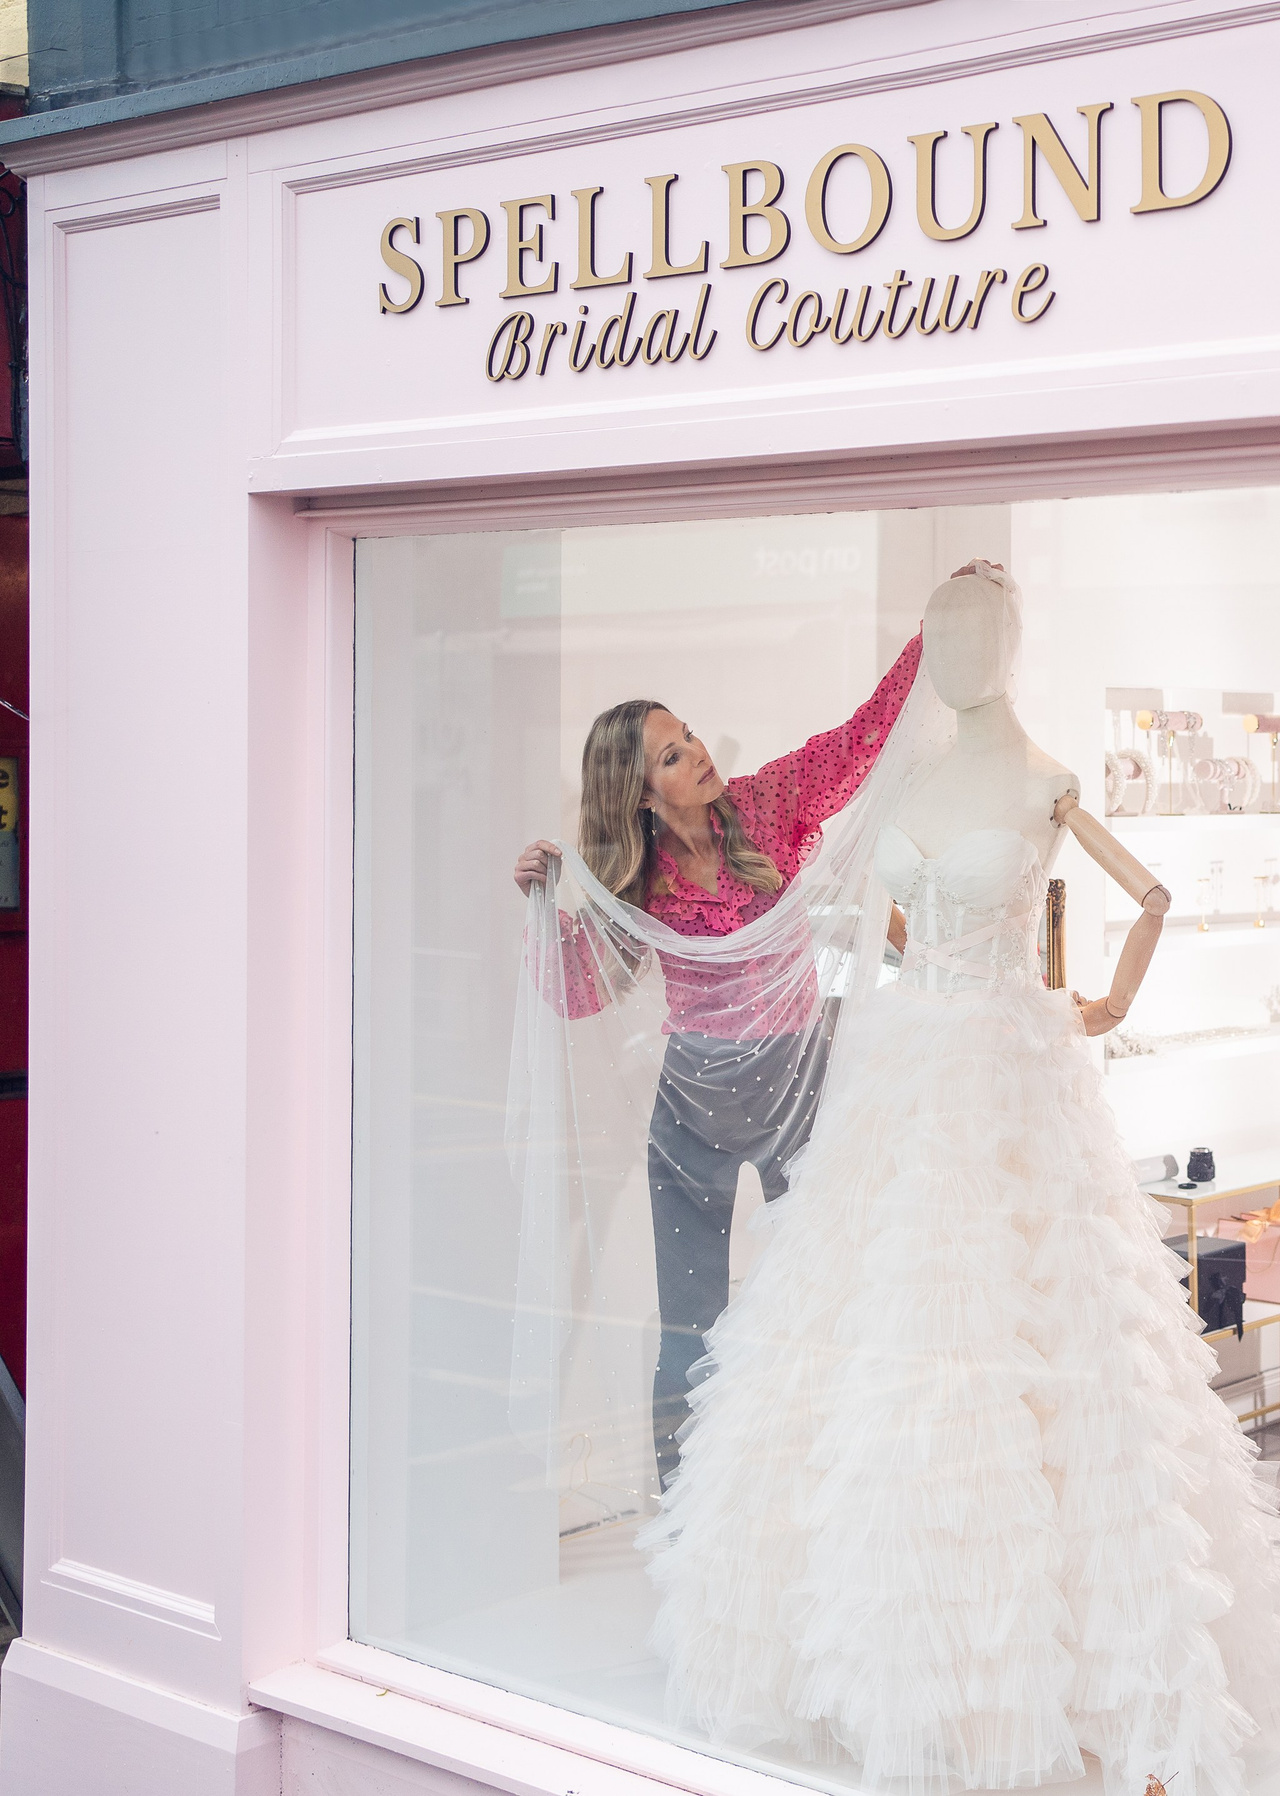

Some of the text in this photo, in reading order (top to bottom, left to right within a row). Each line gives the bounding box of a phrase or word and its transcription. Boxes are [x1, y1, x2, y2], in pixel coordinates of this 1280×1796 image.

[378, 88, 1234, 315] SPELLBOUND
[485, 261, 1058, 382] Bridal Couture
